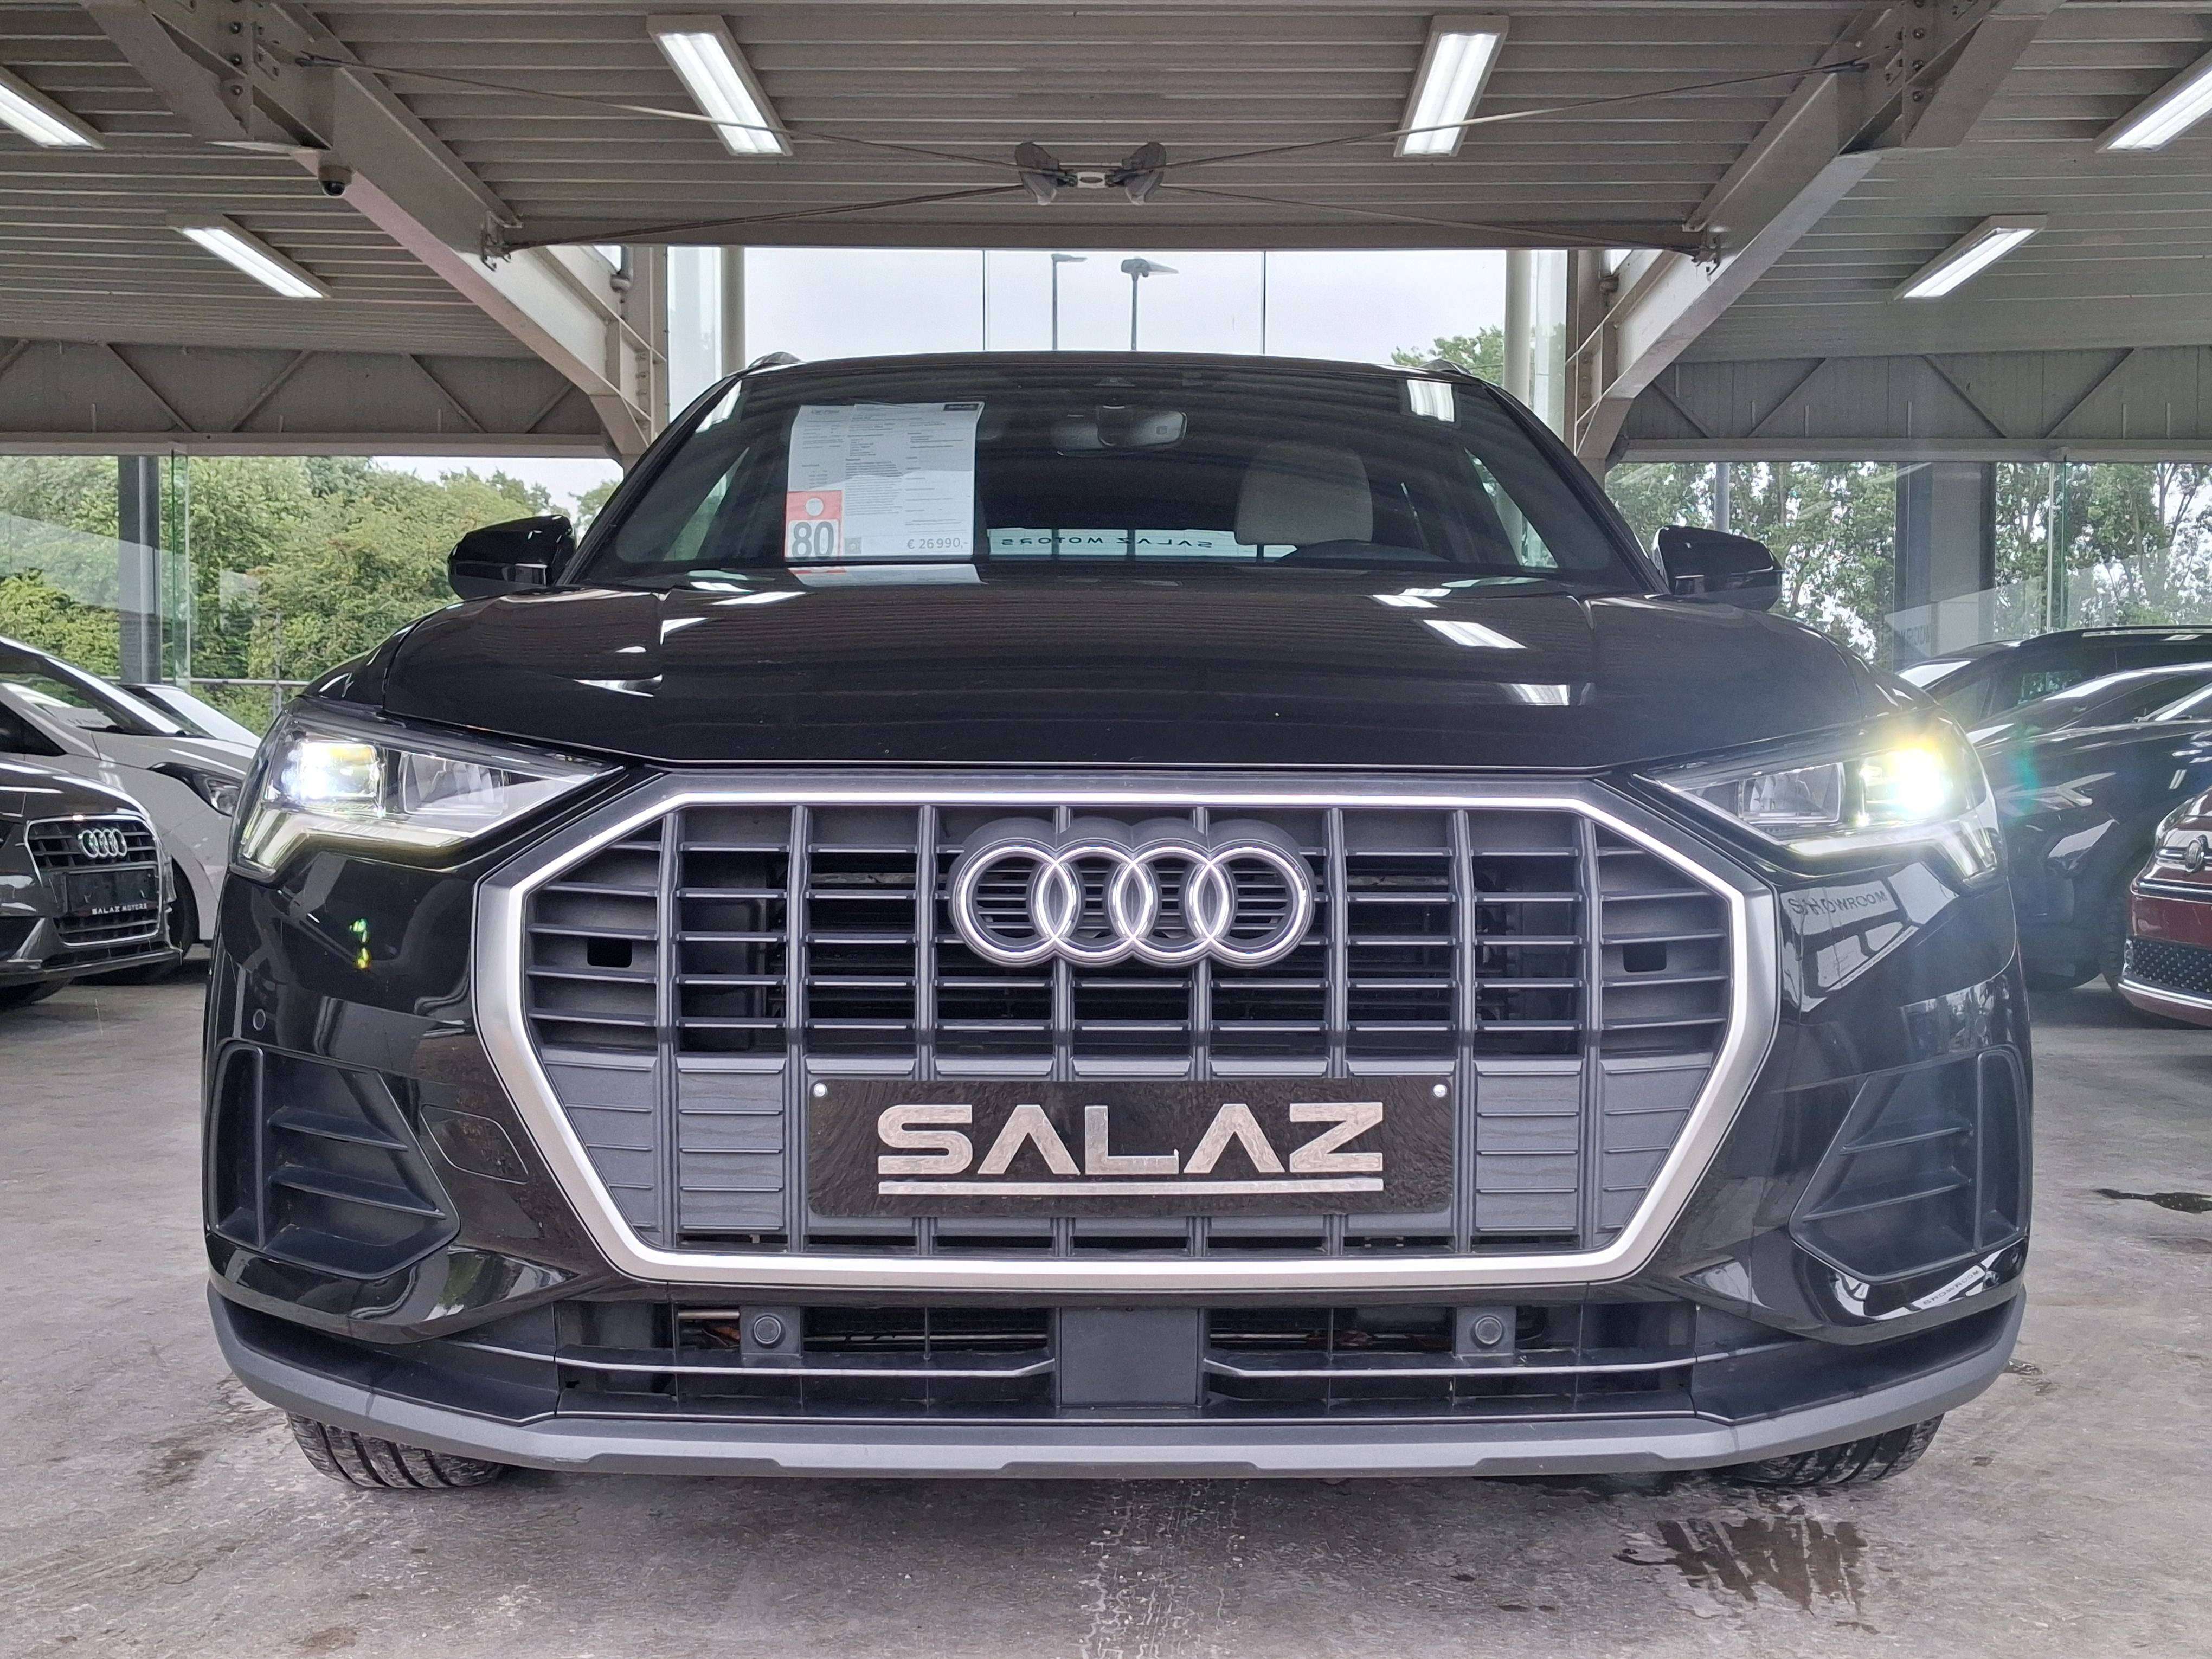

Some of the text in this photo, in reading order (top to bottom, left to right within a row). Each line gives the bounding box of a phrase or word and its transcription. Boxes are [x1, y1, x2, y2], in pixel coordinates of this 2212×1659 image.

[792, 521, 834, 560] 80
[907, 539, 915, 549] €
[1789, 890, 1888, 915] SHOWROOM
[877, 1101, 1384, 1175] SALAZ
